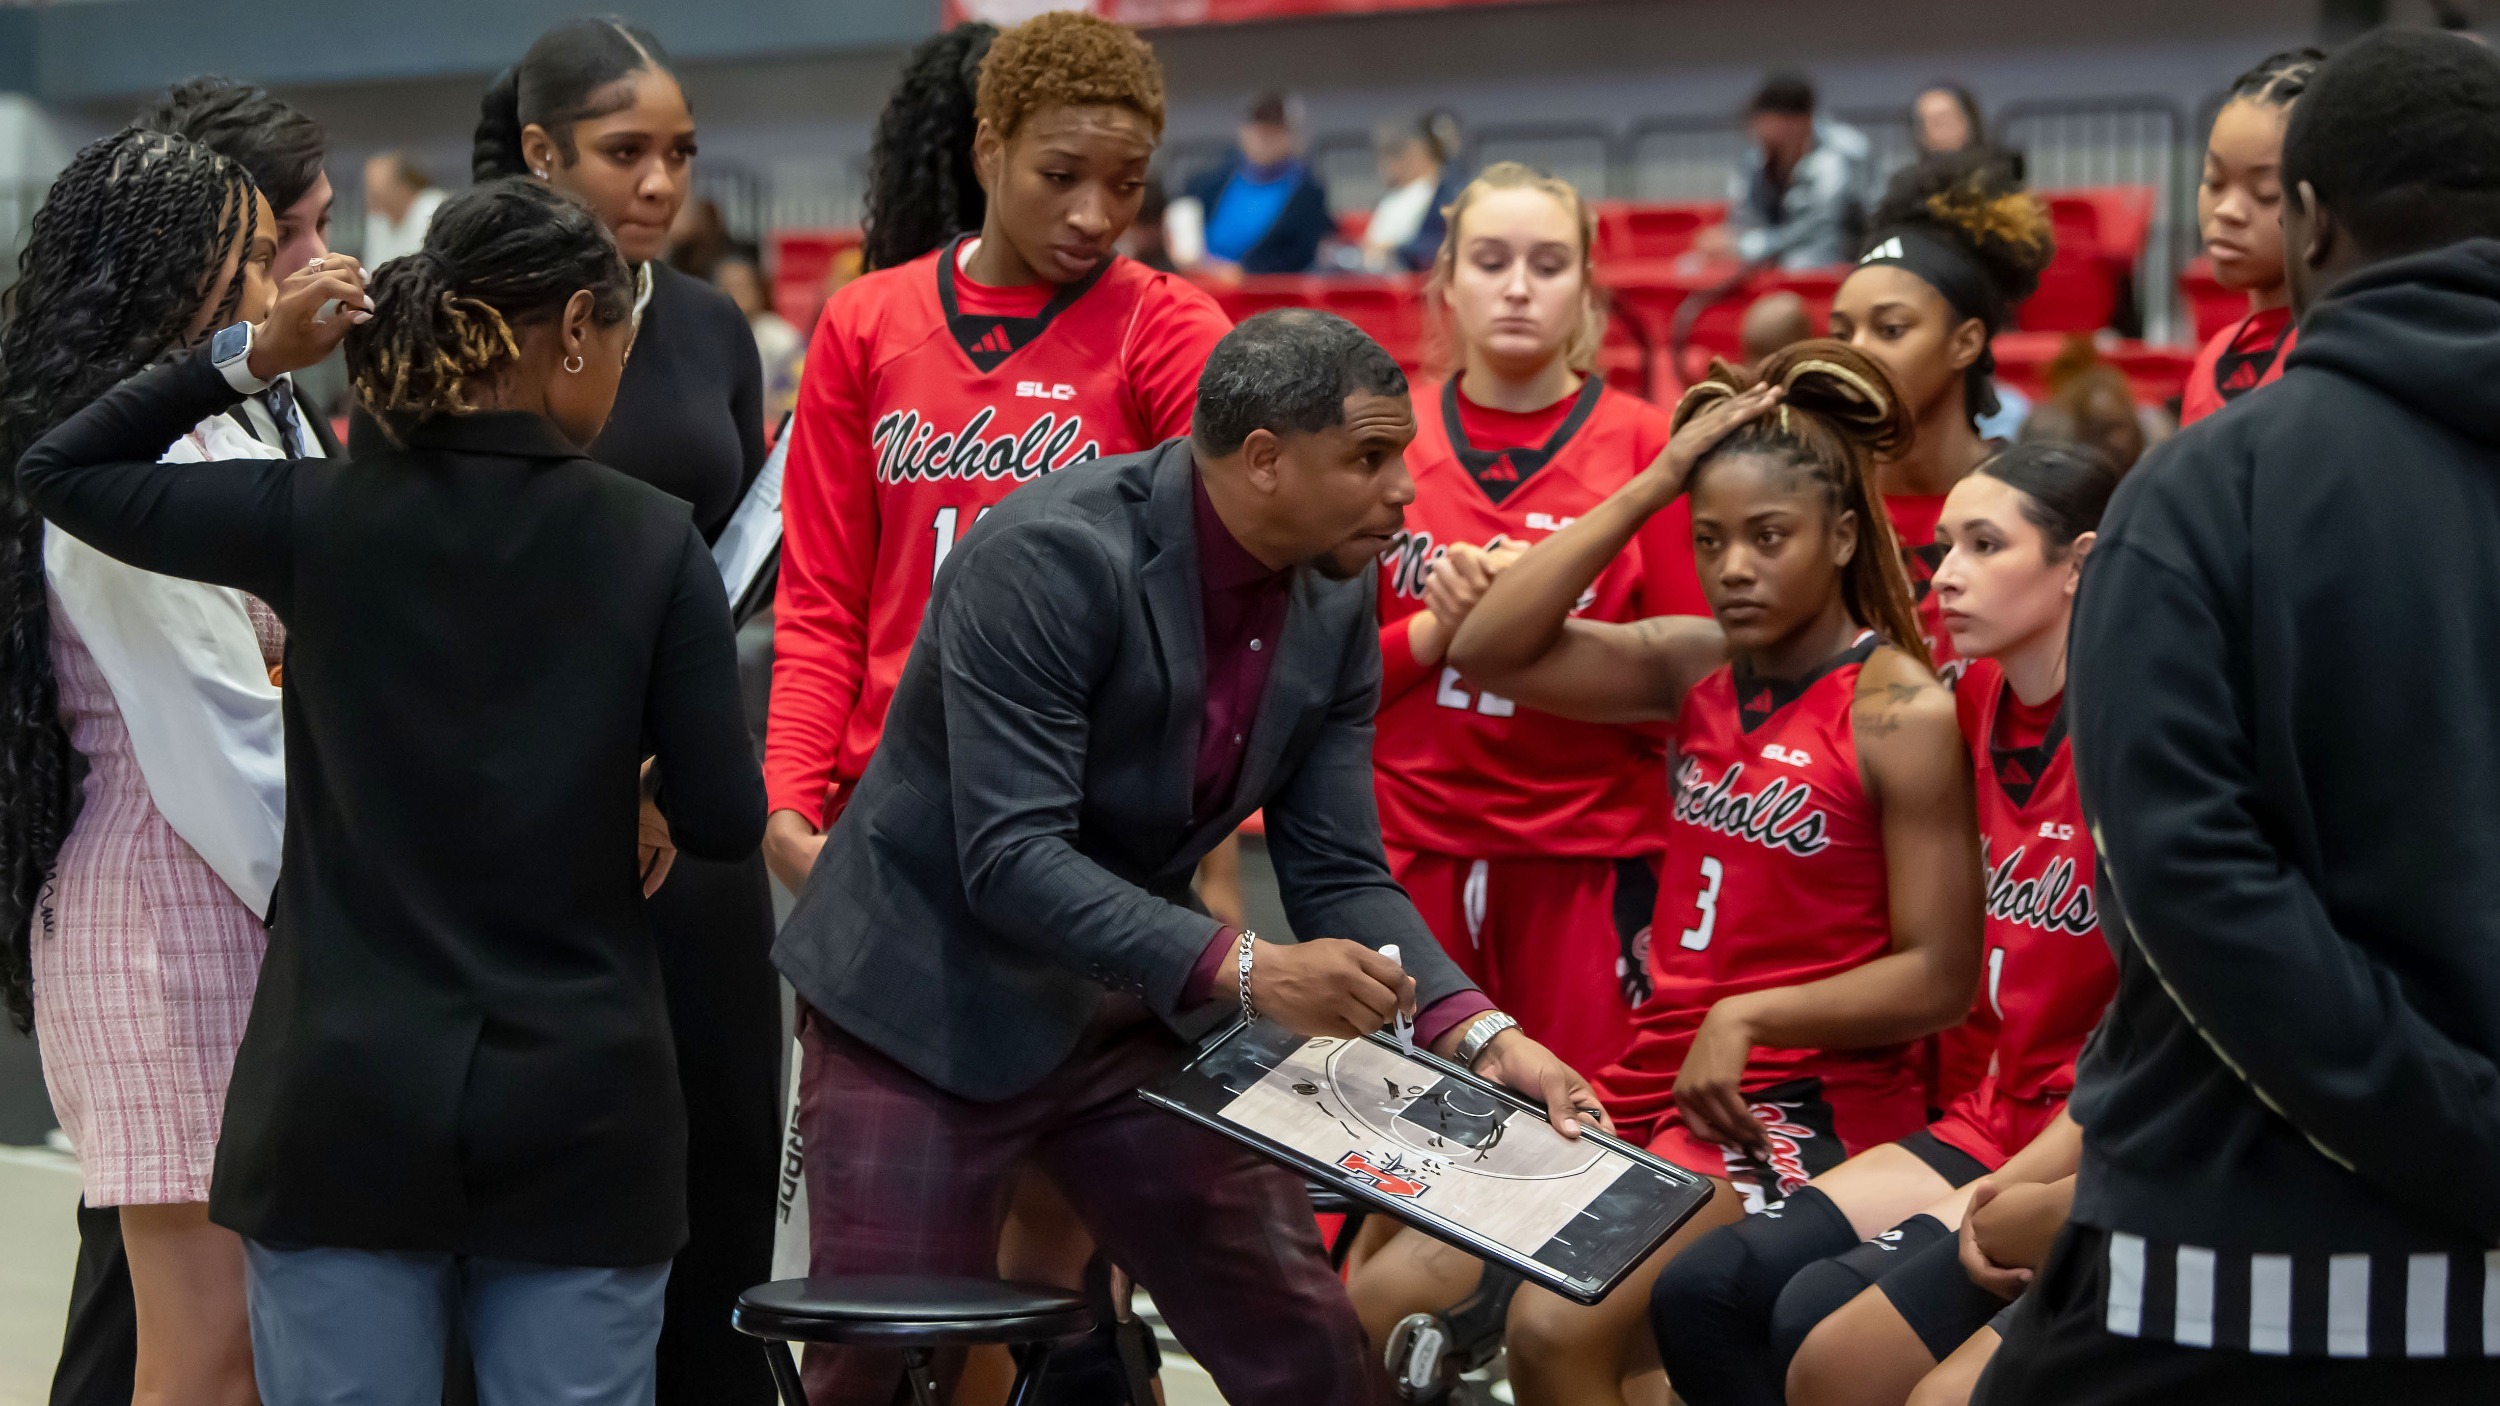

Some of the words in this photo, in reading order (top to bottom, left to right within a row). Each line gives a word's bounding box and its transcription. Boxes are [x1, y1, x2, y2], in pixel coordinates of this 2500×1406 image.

[1673, 754, 1831, 857] icholls
[1679, 855, 1724, 952] 3
[1981, 832, 2098, 937] holls
